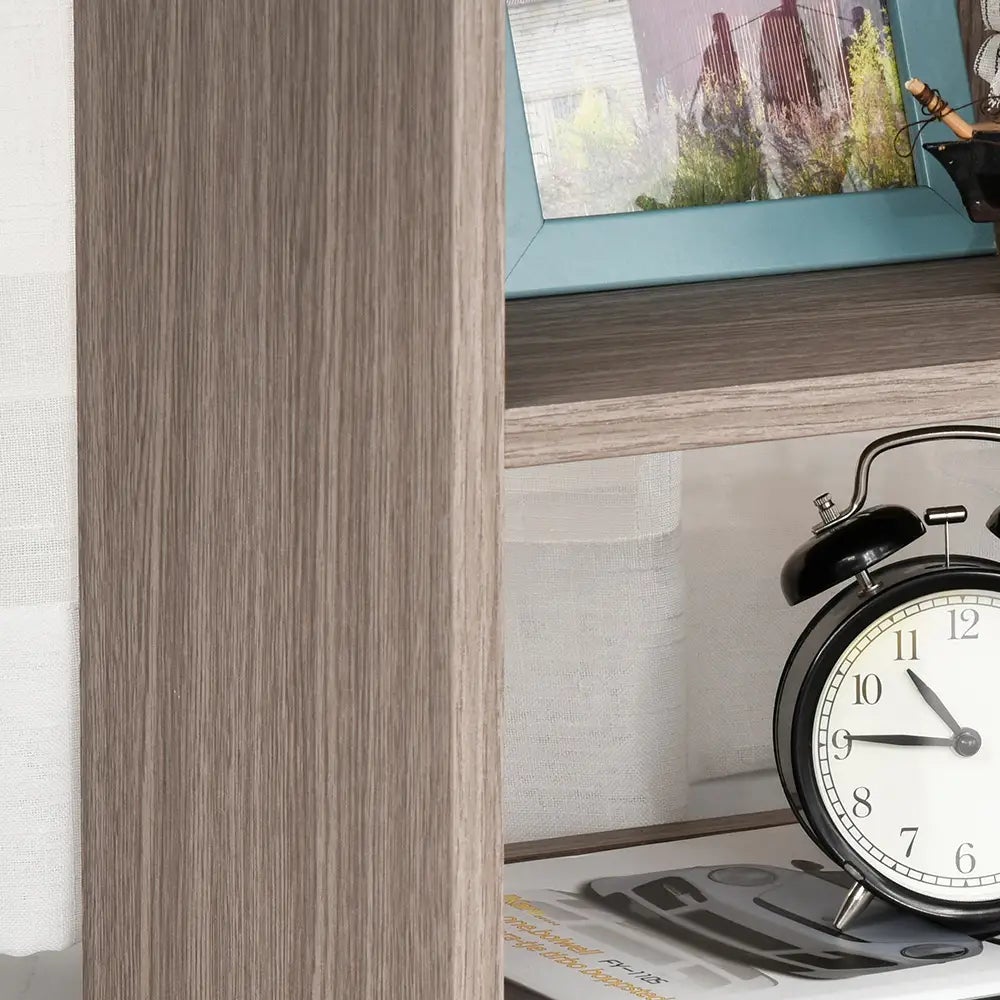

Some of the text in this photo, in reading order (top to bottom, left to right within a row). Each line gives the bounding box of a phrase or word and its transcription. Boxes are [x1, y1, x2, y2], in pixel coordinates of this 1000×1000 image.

[947, 608, 980, 640] 12
[893, 629, 921, 662] 11
[851, 673, 883, 706] 10
[831, 728, 853, 761] 9
[852, 786, 873, 818] 8
[899, 826, 919, 858] 7
[955, 842, 976, 875] 6
